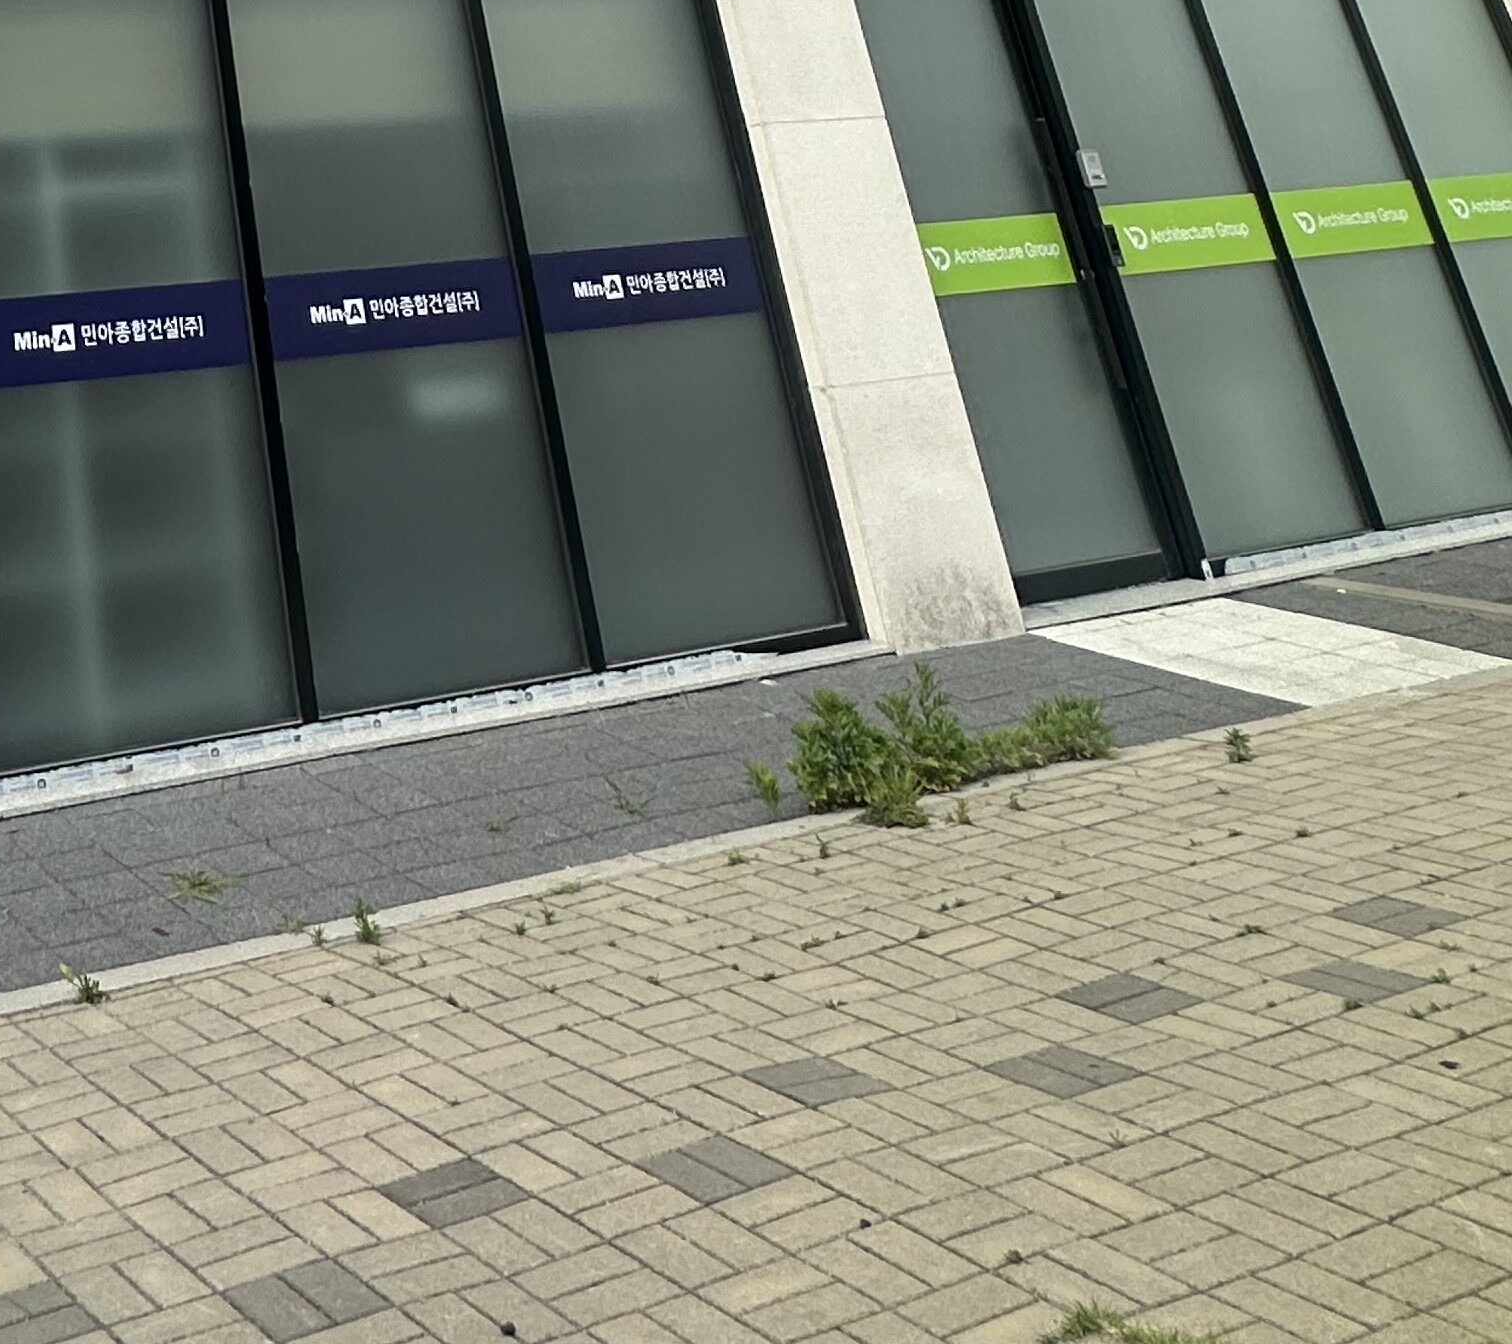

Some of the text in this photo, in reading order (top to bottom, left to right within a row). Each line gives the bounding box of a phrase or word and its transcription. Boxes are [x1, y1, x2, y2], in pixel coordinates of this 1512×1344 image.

[1317, 206, 1409, 229] Architecture Group
[1150, 221, 1250, 245] Architecture Group
[953, 241, 1061, 265] Architecture Group
[626, 266, 726, 296] 민아종합건설[주]
[370, 290, 481, 320] 민아종합건설[주]
[81, 315, 205, 347] 민아종합건설[주]
